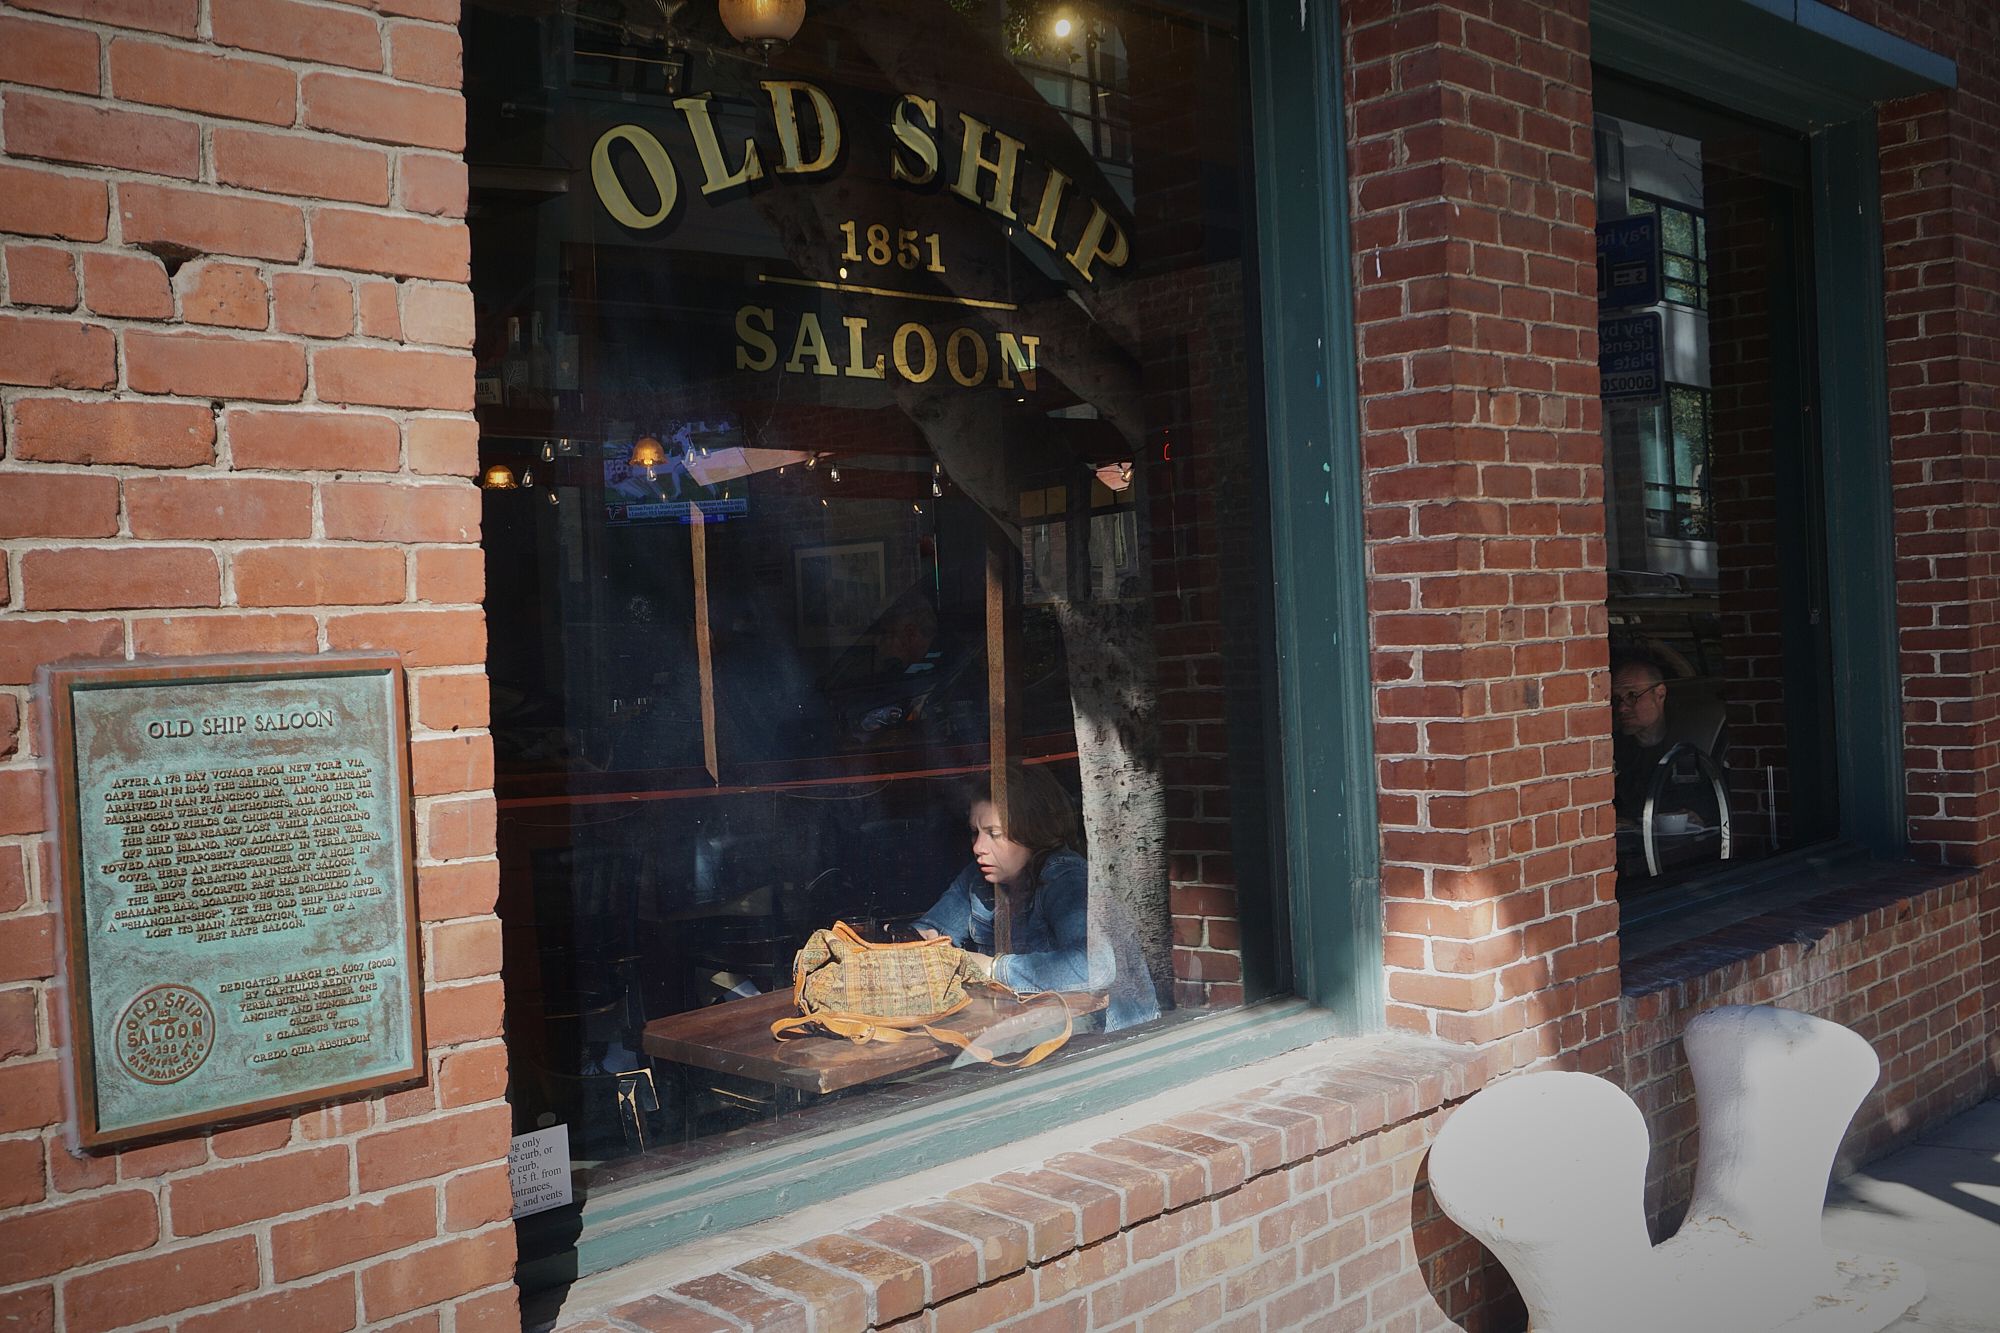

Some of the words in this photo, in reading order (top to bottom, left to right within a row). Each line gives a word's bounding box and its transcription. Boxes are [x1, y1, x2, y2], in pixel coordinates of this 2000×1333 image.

[590, 79, 841, 230] OLD
[890, 93, 1130, 284] SHIP
[838, 219, 946, 274] 1851
[734, 305, 1041, 393] SALOON
[149, 719, 194, 739] OLD
[202, 716, 247, 736] SHIP
[254, 710, 333, 732] SALOON
[104, 790, 134, 801] CAPE
[138, 787, 168, 798] HORN
[170, 786, 182, 795] IN
[214, 781, 235, 791] THE
[238, 777, 279, 788] SAILING
[283, 774, 306, 784] SHIP
[112, 777, 150, 789] AFTER
[152, 776, 161, 785] A
[184, 772, 206, 782] DAY
[211, 768, 252, 780] VOYAGE
[256, 765, 284, 775] FROM
[289, 763, 311, 772] NEW
[315, 760, 342, 770] YORK
[347, 758, 364, 767] VIA
[104, 810, 174, 825] PASSENGERS
[176, 806, 208, 817] WERE
[296, 795, 316, 805] ALL
[320, 791, 352, 802] BOUND
[356, 789, 375, 799] FOR
[105, 800, 156, 813] ARRIVED
[160, 798, 172, 808] IN
[175, 796, 197, 806] SAN
[200, 790, 259, 804] FRANCISCO
[292, 783, 329, 794] AMONG
[335, 780, 355, 790] HER
[120, 837, 142, 847] THE
[147, 834, 170, 844] SHIP
[174, 831, 197, 841] WAS
[199, 826, 241, 839] NEARLY
[246, 822, 270, 833] LOST
[277, 818, 308, 830] WHILE
[312, 812, 370, 826] ANCHORING
[123, 825, 145, 835] THE
[150, 821, 179, 832] GOLD
[183, 817, 219, 829] FIELDS
[222, 815, 237, 825] OR
[242, 810, 283, 822] CHURCH
[288, 802, 358, 817] PROPAGATION.
[101, 861, 144, 874] TOWED
[147, 857, 172, 868] AND
[176, 850, 236, 865] PURPOSELY
[240, 842, 294, 857] GROUNDED
[299, 840, 310, 850] IN
[314, 836, 347, 848] YERBA
[350, 832, 381, 844] BUENA
[123, 849, 142, 859] OFF
[146, 845, 173, 856] BIRD
[224, 837, 247, 848] NOW
[313, 826, 340, 837] THEN
[344, 824, 363, 834] WAS
[134, 882, 158, 893] HER
[161, 878, 186, 890] BOW
[192, 870, 247, 886] CREATING
[250, 867, 266, 877] AN
[270, 862, 311, 875] INSTANT
[316, 856, 357, 869] SALOON.
[157, 867, 188, 878] HERE
[191, 865, 208, 874] AN
[212, 855, 293, 872] ENTREPRENEUR
[298, 851, 316, 861] CUT
[320, 850, 328, 859] A
[330, 847, 354, 858] HOLE
[359, 845, 370, 854] IN
[114, 904, 170, 919] SEAMAN'S
[200, 892, 256, 908] BOARDING
[299, 879, 349, 894] BORDELLO
[352, 876, 374, 887] AND
[127, 895, 148, 906] THE
[154, 890, 186, 903] SHIP'S
[191, 882, 247, 898] COLORFUL
[250, 878, 274, 889] PAST
[278, 875, 300, 886] HAS
[302, 868, 351, 883] INCLUDED
[354, 867, 362, 876] A
[108, 923, 118, 933] A
[230, 905, 248, 916] YET
[252, 901, 272, 912] THE
[277, 898, 296, 908] OLD
[301, 894, 323, 905] SHIP
[326, 891, 347, 902] HAS
[349, 886, 382, 898] NEVER
[145, 926, 172, 938] LOST
[177, 923, 194, 934] ITS
[196, 919, 224, 931] MAIN
[301, 905, 328, 916] THAT
[333, 902, 345, 912] OF
[347, 901, 355, 910] A
[196, 930, 227, 943] FIRST
[230, 926, 258, 938] RATE
[262, 918, 306, 933] SALOON.
[220, 976, 280, 993] DEDICATED
[285, 970, 321, 983] MARCH
[240, 999, 273, 1012] YERBA
[276, 993, 310, 1006] BUENA
[313, 985, 354, 1000] NUMBER
[360, 982, 378, 993] ONE
[245, 990, 258, 1000] BY
[126, 998, 157, 1030] OLD
[164, 992, 203, 1018] SHIP
[242, 1007, 288, 1023] ANCIENT
[290, 1003, 312, 1015] AND
[316, 993, 372, 1010] HONORABLE
[290, 1013, 322, 1026] ORDER
[327, 1010, 337, 1019] OF
[126, 1020, 203, 1048] SALOON
[266, 1032, 272, 1041] E
[332, 1018, 359, 1030] VITUS
[147, 1043, 204, 1079] FRANCISCO
[254, 1049, 288, 1063] CREDO
[292, 1044, 315, 1057] QUIA
[522, 1136, 541, 1148] only
[544, 1146, 553, 1155] or
[518, 1174, 528, 1184] 15
[541, 1166, 562, 1179] from
[523, 1195, 539, 1207] and
[541, 1189, 563, 1201] vents
